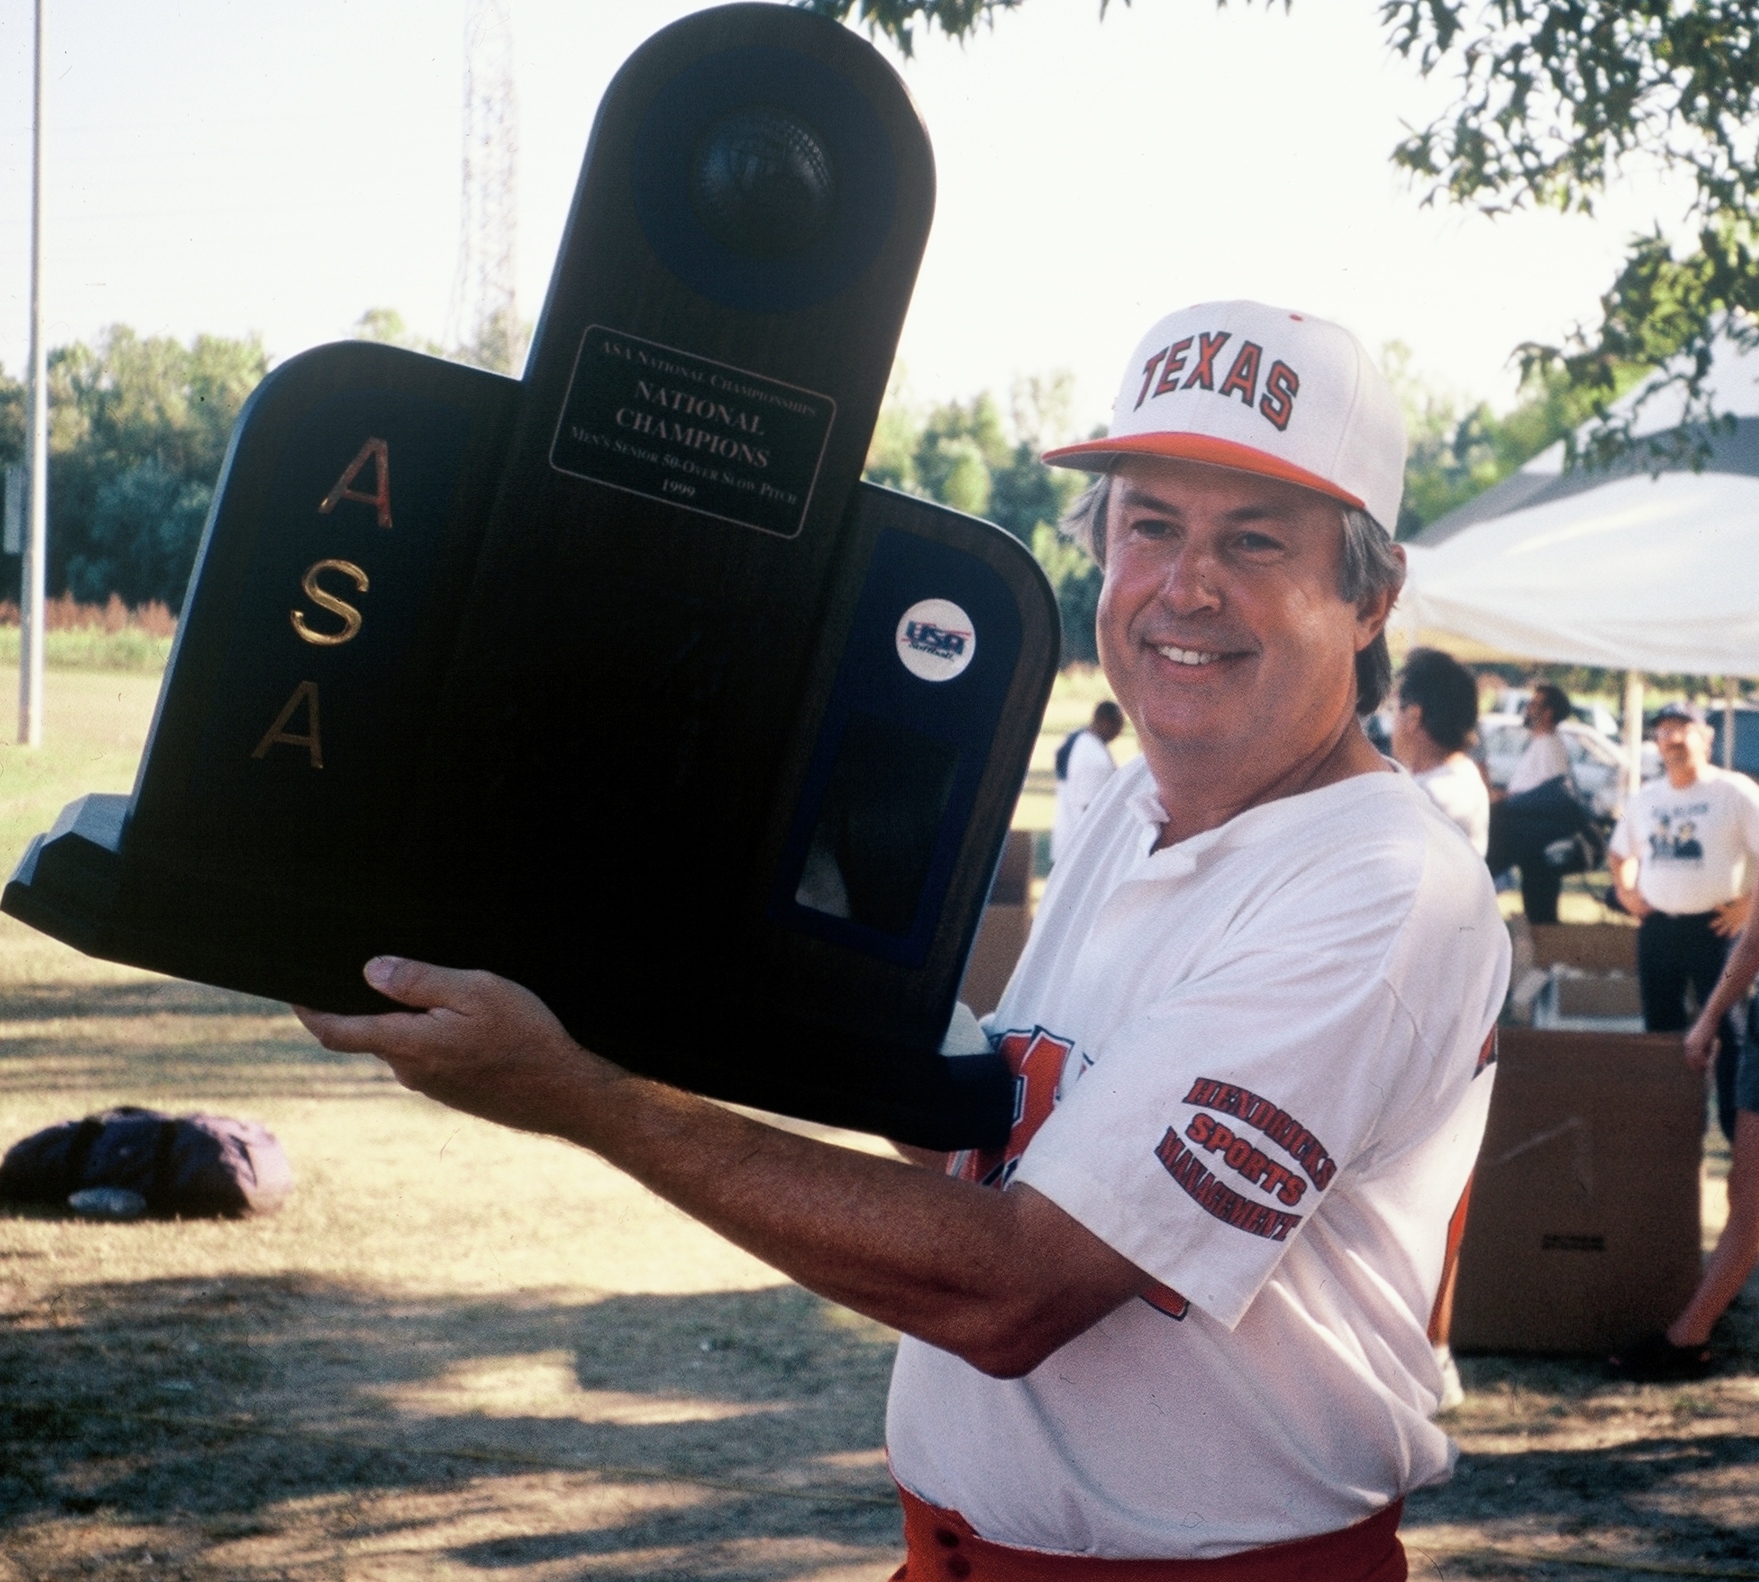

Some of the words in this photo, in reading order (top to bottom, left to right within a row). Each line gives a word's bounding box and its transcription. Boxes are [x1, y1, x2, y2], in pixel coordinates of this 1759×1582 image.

[602, 340, 633, 361] ASA
[638, 350, 705, 383] NATIONAL
[710, 373, 817, 418] CHAMPIONSHIPS
[633, 380, 765, 436] NATIONAL
[1133, 331, 1300, 432] TEXAS
[613, 439, 659, 463] SENIOR
[721, 469, 757, 491] SLOW
[758, 482, 798, 506] PITCH
[615, 407, 770, 469] CHAMPIONS
[661, 478, 696, 499] 1999
[905, 620, 966, 656] USA
[1181, 1076, 1338, 1193] HENDRICKS
[1184, 1112, 1308, 1207] SPORTS
[1153, 1125, 1303, 1242] MANAGEMENT
